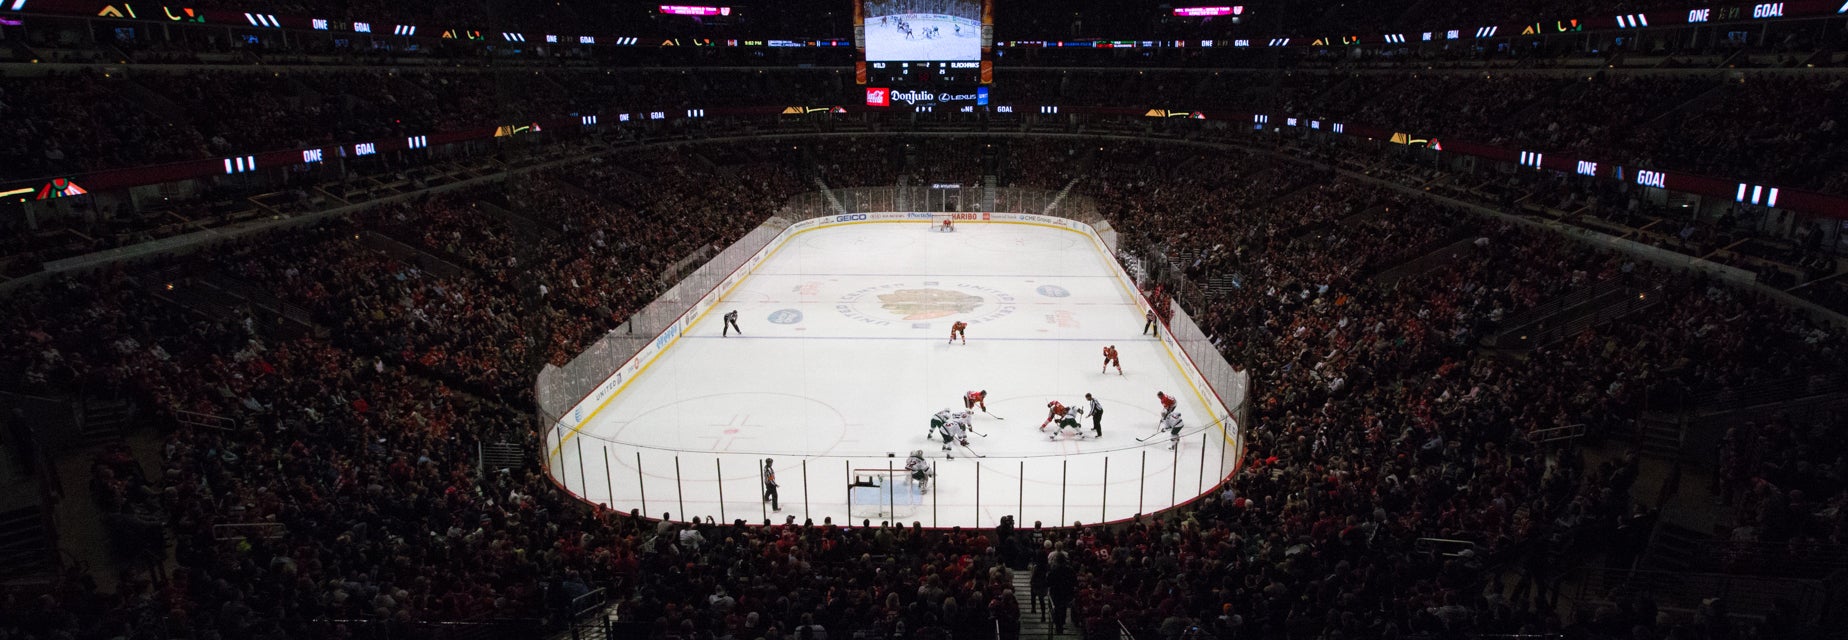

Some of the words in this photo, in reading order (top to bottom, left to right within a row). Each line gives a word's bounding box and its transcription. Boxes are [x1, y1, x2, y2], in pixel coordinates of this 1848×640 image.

[1688, 8, 1710, 23] ONE
[1753, 2, 1784, 18] GOAL
[312, 18, 328, 30] ONE
[354, 22, 371, 33] GOAL
[580, 36, 595, 44] GOAL
[1447, 30, 1459, 39] GOAL
[1234, 39, 1249, 47] GOAL
[650, 111, 665, 120] GOAL
[303, 149, 322, 163] ONE
[355, 143, 376, 156] GOAL
[1577, 160, 1597, 176] ONE
[1637, 169, 1665, 188] GOAL
[837, 214, 867, 222] GEICO
[595, 379, 616, 401] UNITED
